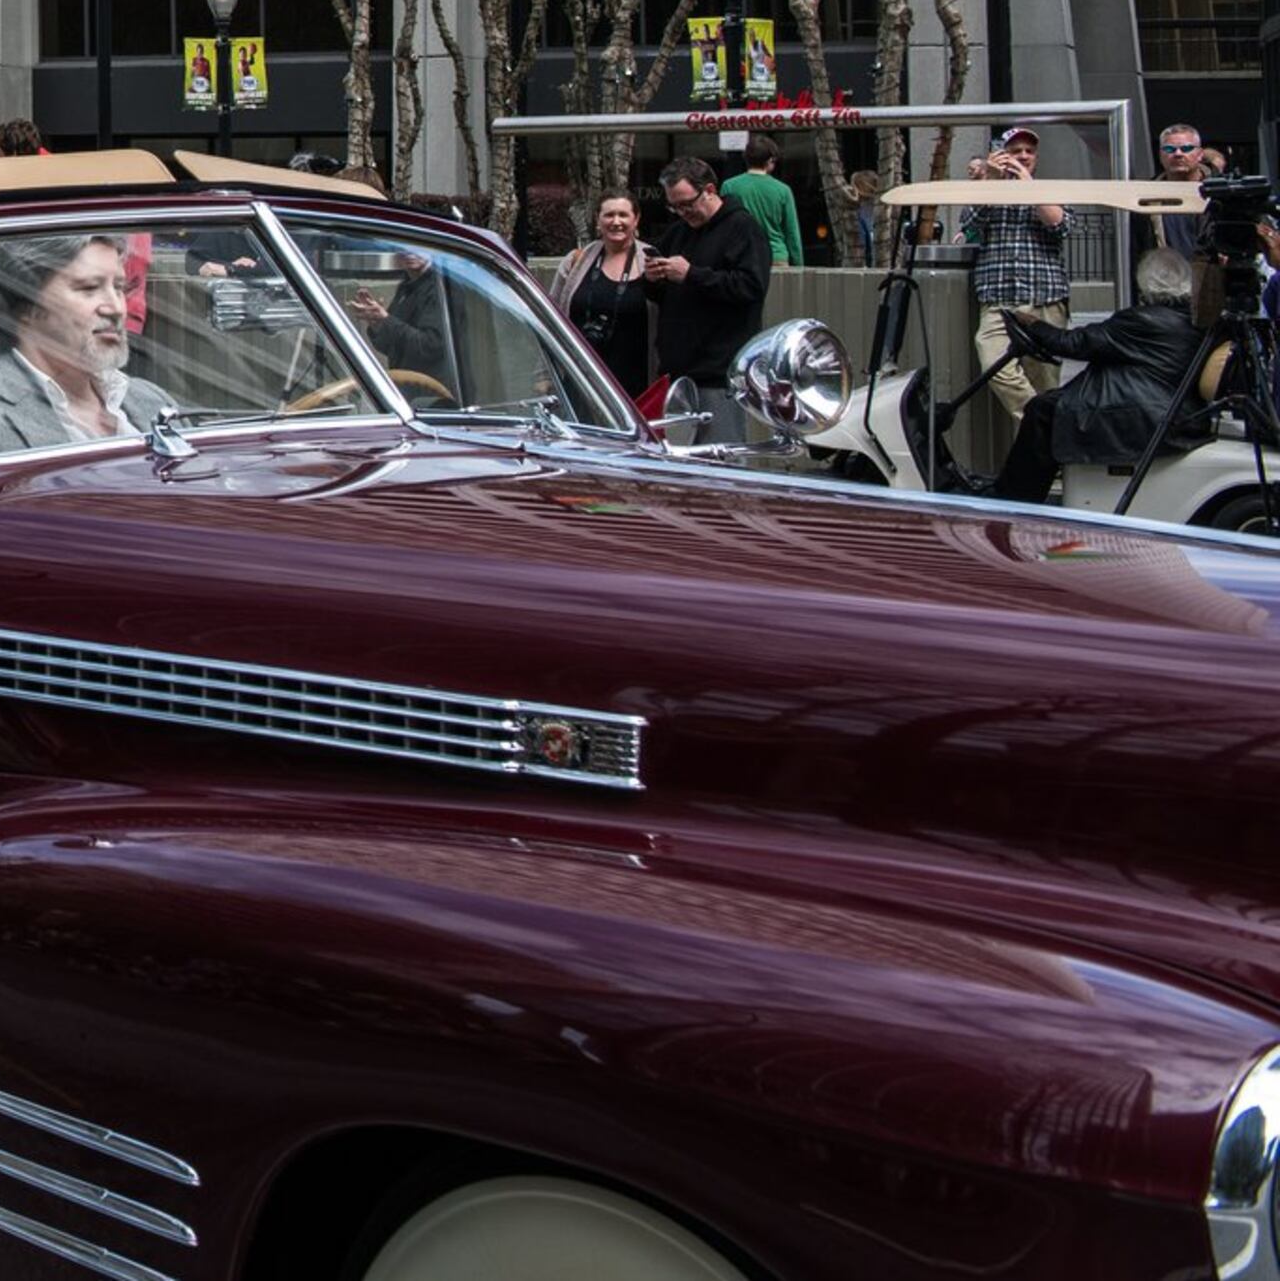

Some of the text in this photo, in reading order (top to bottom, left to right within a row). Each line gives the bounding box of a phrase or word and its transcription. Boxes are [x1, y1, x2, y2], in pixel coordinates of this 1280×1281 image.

[685, 107, 867, 131] Clearance 6ft. 7in.
